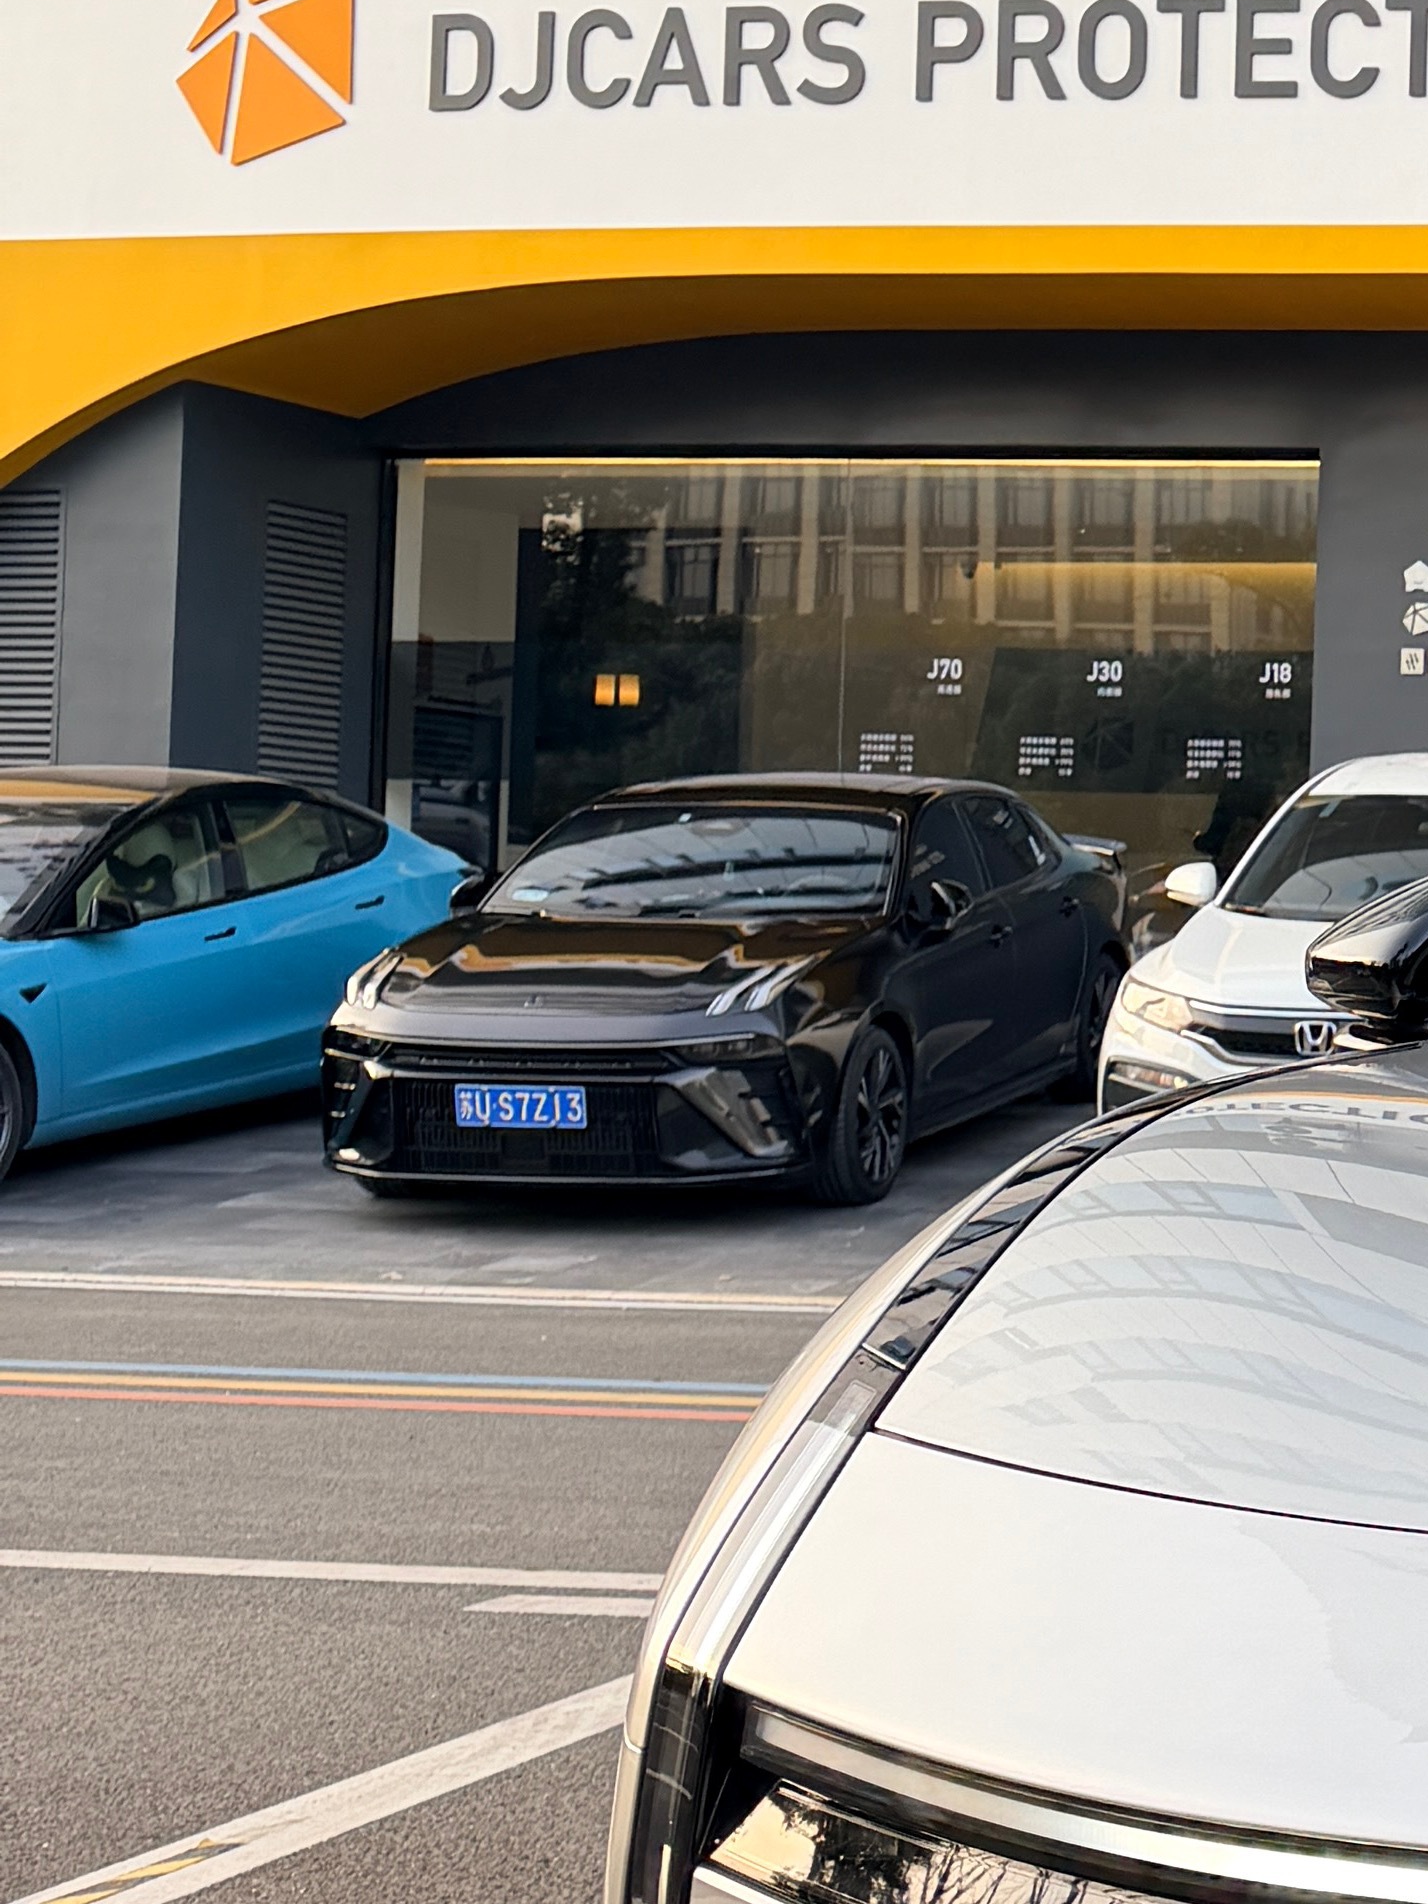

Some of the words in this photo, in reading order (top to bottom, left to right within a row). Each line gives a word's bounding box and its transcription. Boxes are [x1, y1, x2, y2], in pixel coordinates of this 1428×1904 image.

[430, 4, 865, 112] DJCARS
[926, 658, 963, 680] J70
[1086, 660, 1123, 682] J30
[1259, 662, 1292, 684] J18
